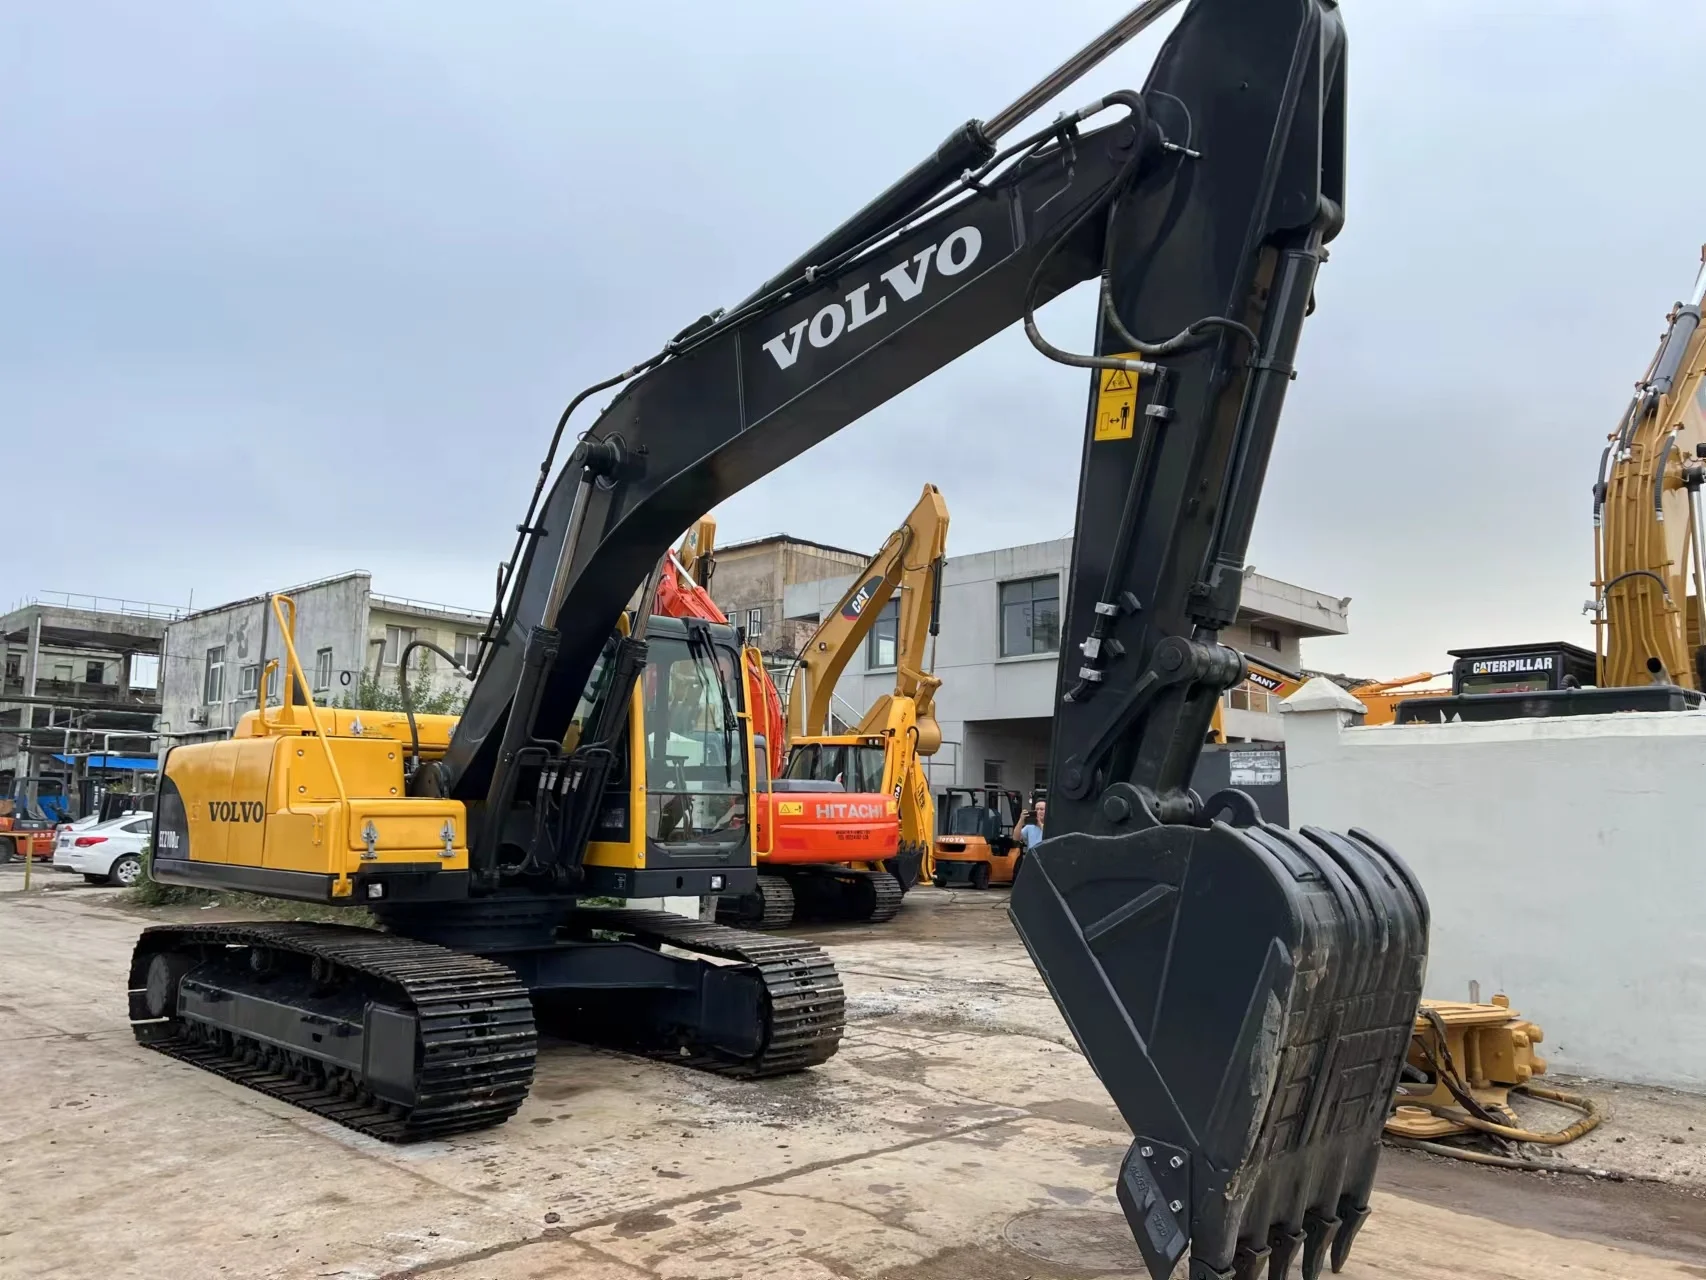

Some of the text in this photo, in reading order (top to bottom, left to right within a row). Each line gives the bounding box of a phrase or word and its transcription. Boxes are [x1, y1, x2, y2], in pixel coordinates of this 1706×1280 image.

[762, 225, 982, 371] VOLVO
[851, 586, 870, 614] CAT
[1473, 657, 1552, 675] CATERPILLAR
[1249, 673, 1276, 690] SANY
[208, 801, 264, 823] VOLVO
[815, 803, 883, 819] HITACHI
